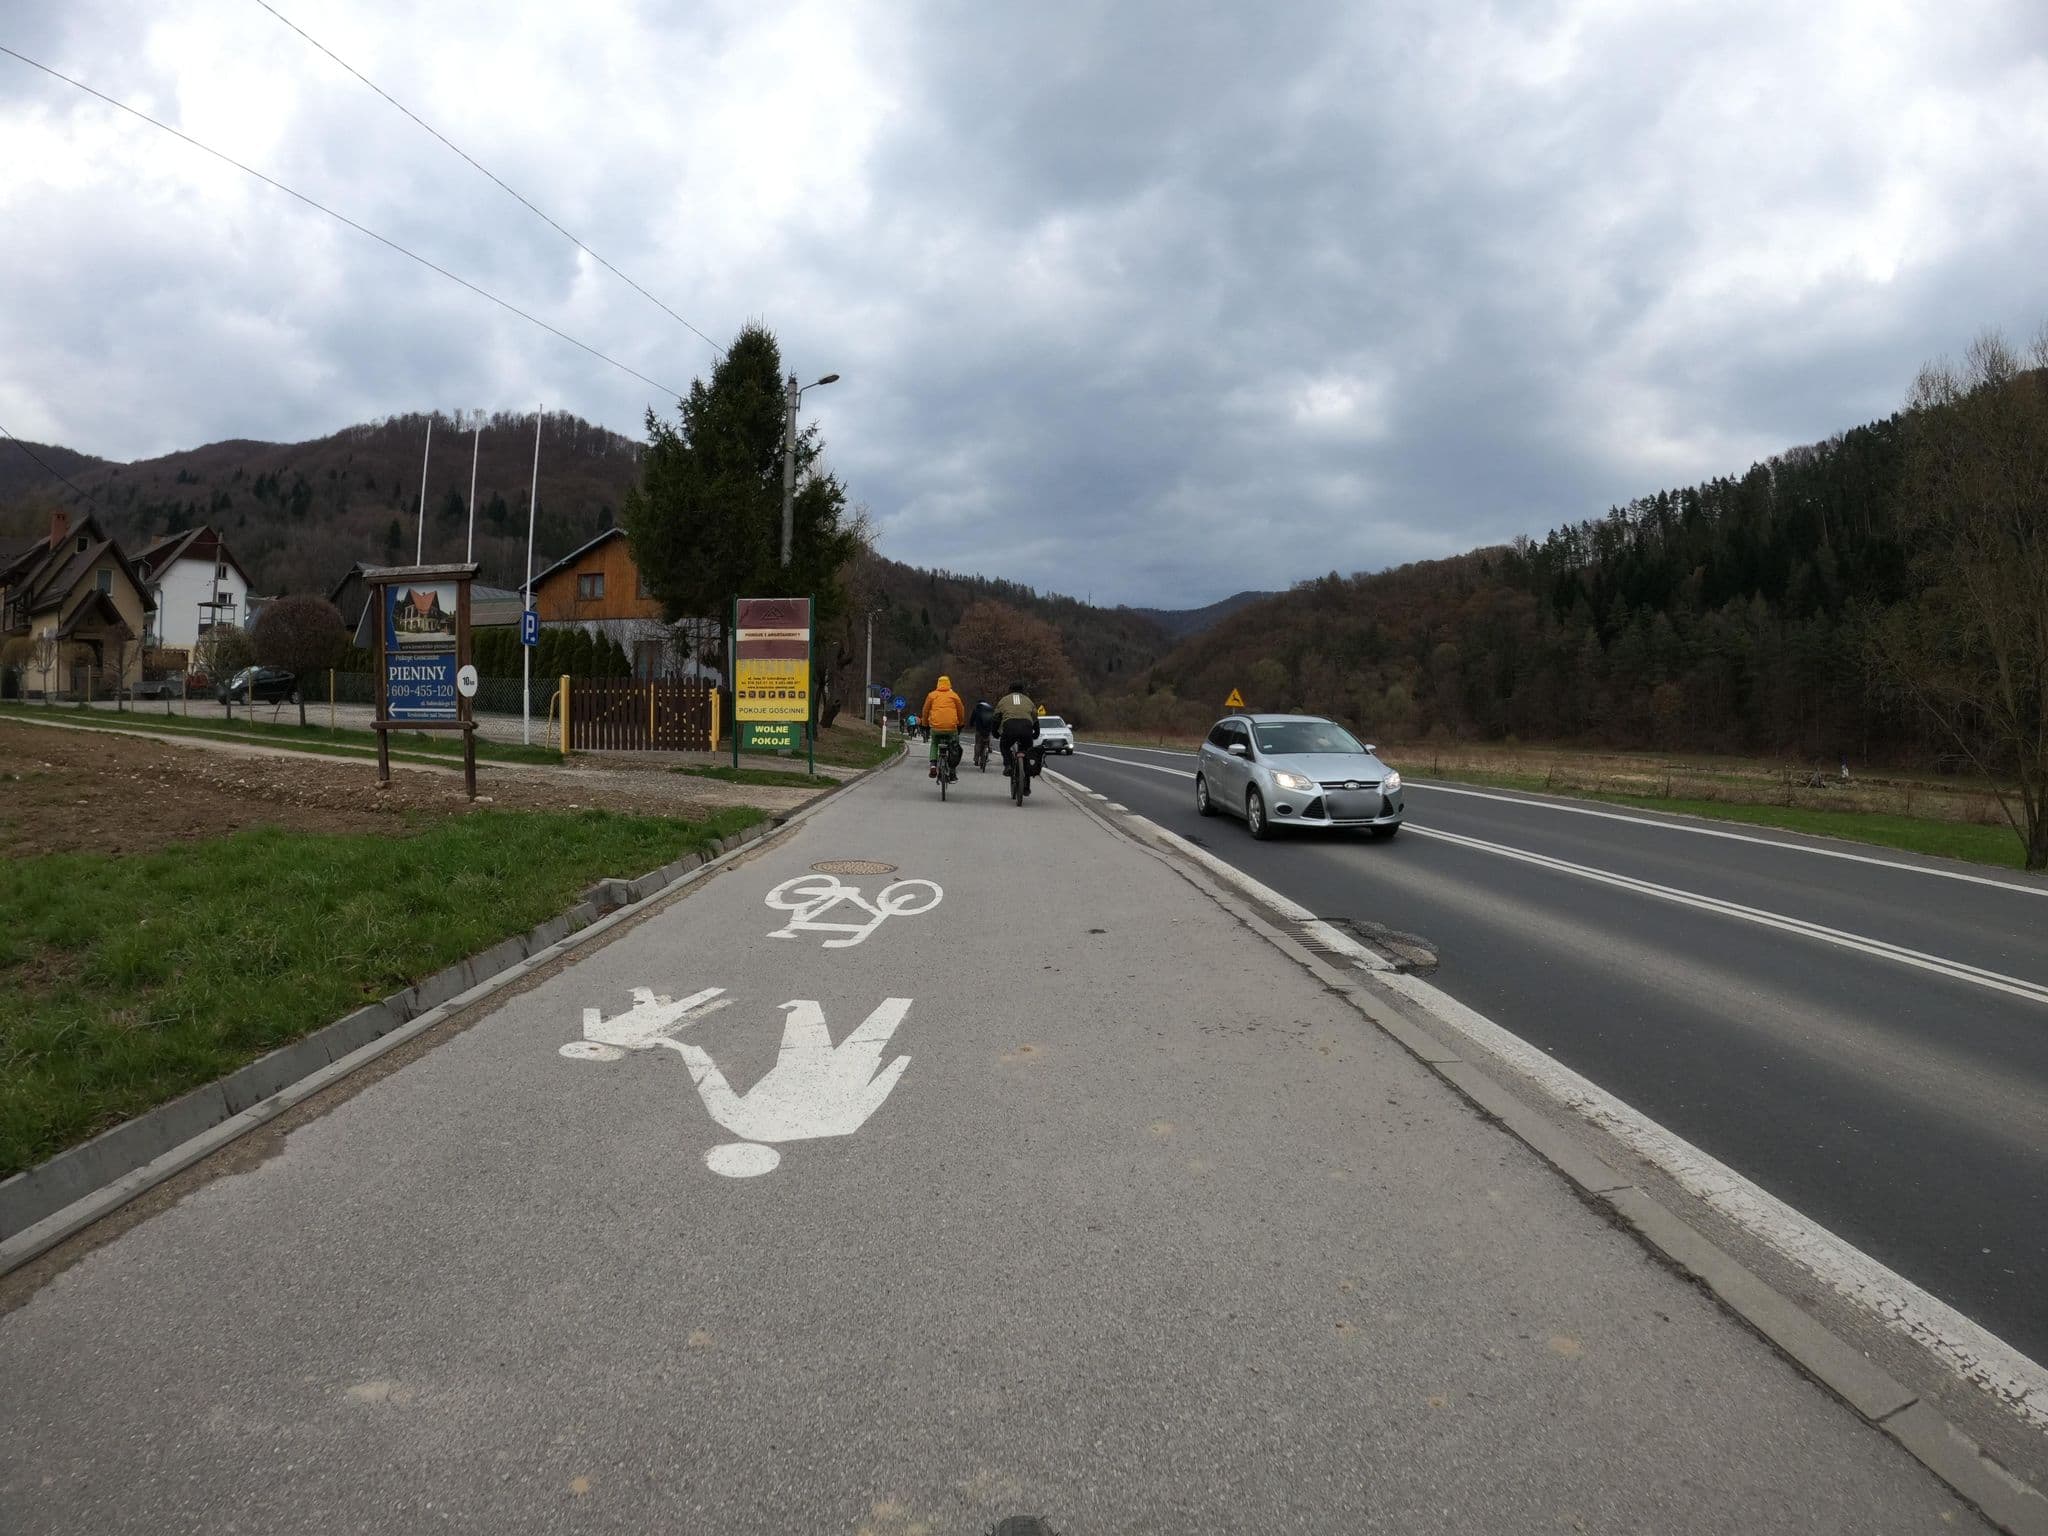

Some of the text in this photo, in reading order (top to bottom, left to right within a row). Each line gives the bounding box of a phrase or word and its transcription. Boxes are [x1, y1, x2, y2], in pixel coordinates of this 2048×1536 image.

[389, 665, 447, 681] PIENINY
[462, 676, 470, 686] 10
[391, 684, 454, 697] 609-455-120
[754, 725, 789, 733] WOLNE
[751, 737, 791, 745] POKOJE
